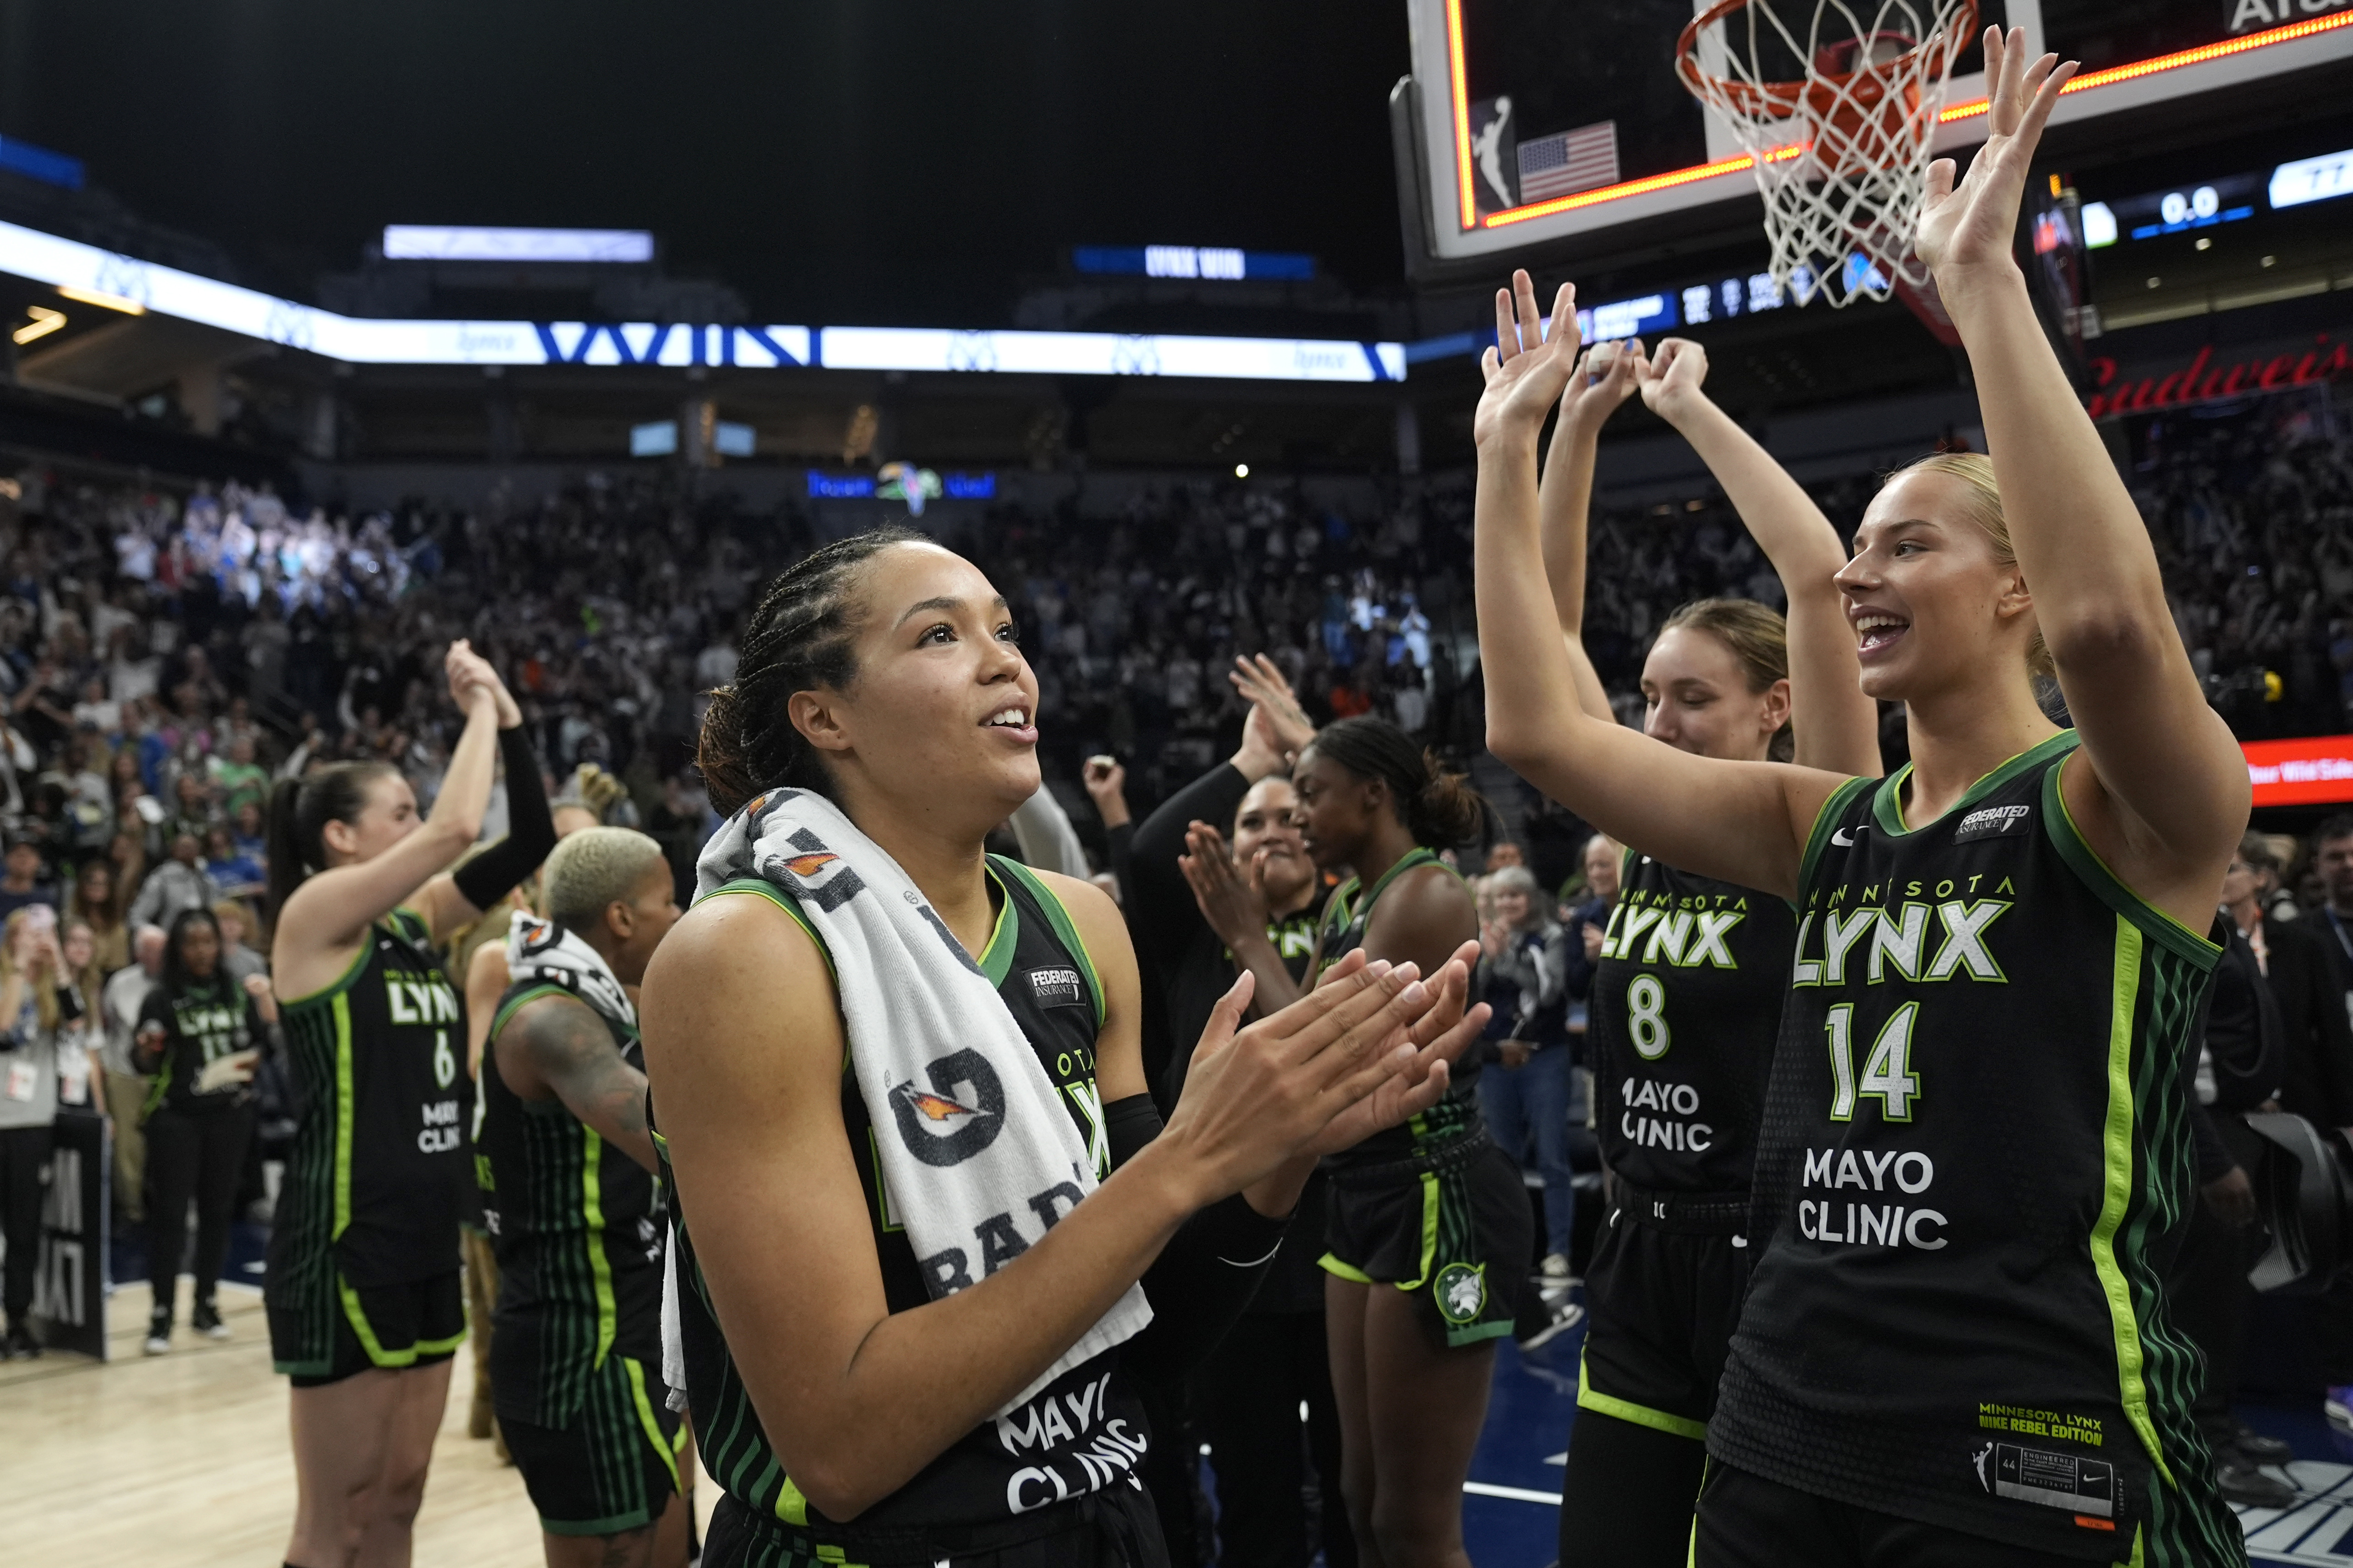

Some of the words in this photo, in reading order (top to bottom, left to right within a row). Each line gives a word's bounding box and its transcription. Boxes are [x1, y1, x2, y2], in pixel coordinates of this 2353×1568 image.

[2161, 186, 2219, 225] 0.0
[533, 321, 821, 368] WIN
[1955, 818, 2001, 835] INSURANCE
[1960, 806, 2029, 827] FEDERATED
[1600, 903, 1746, 969] LYNX
[1792, 898, 2015, 989] LYNX
[1031, 969, 1079, 987] FEDERATED
[1035, 983, 1073, 997] INSURANCE
[386, 980, 459, 1024] LYN
[1627, 973, 1671, 1061] 8
[433, 1029, 456, 1091] 6
[1824, 1001, 1921, 1123] 14
[1621, 1111, 1714, 1152] CINIC
[1803, 1148, 1933, 1194] MAYO
[1799, 1199, 1948, 1250] CLINIC
[1979, 1402, 2060, 1424] MINNESOTA
[2066, 1414, 2102, 1432] LYNX
[1979, 1415, 2008, 1429] NIKE
[2010, 1418, 2049, 1437] REBEL
[2051, 1424, 2103, 1447] EDITION
[1007, 1418, 1147, 1515] CLINIC
[2003, 1459, 2015, 1470] 44
[2024, 1452, 2075, 1466] ENGINEERED
